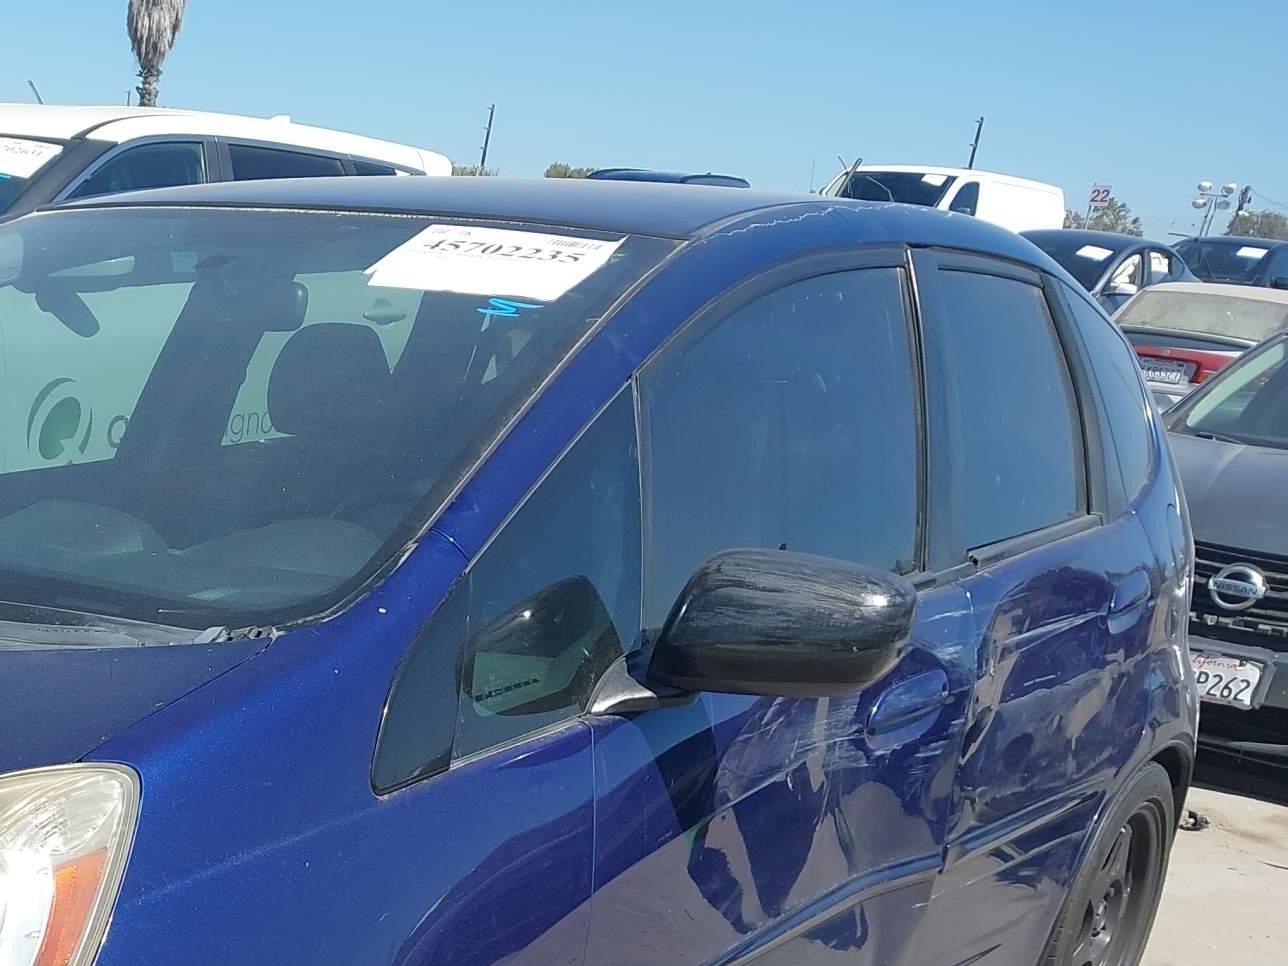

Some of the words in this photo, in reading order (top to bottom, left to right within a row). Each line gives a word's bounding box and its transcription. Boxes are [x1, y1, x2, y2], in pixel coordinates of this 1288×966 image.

[1090, 189, 1110, 202] 22
[423, 238, 586, 264] 45702235
[1213, 581, 1257, 596] NISSAN
[1194, 670, 1251, 701] P262
